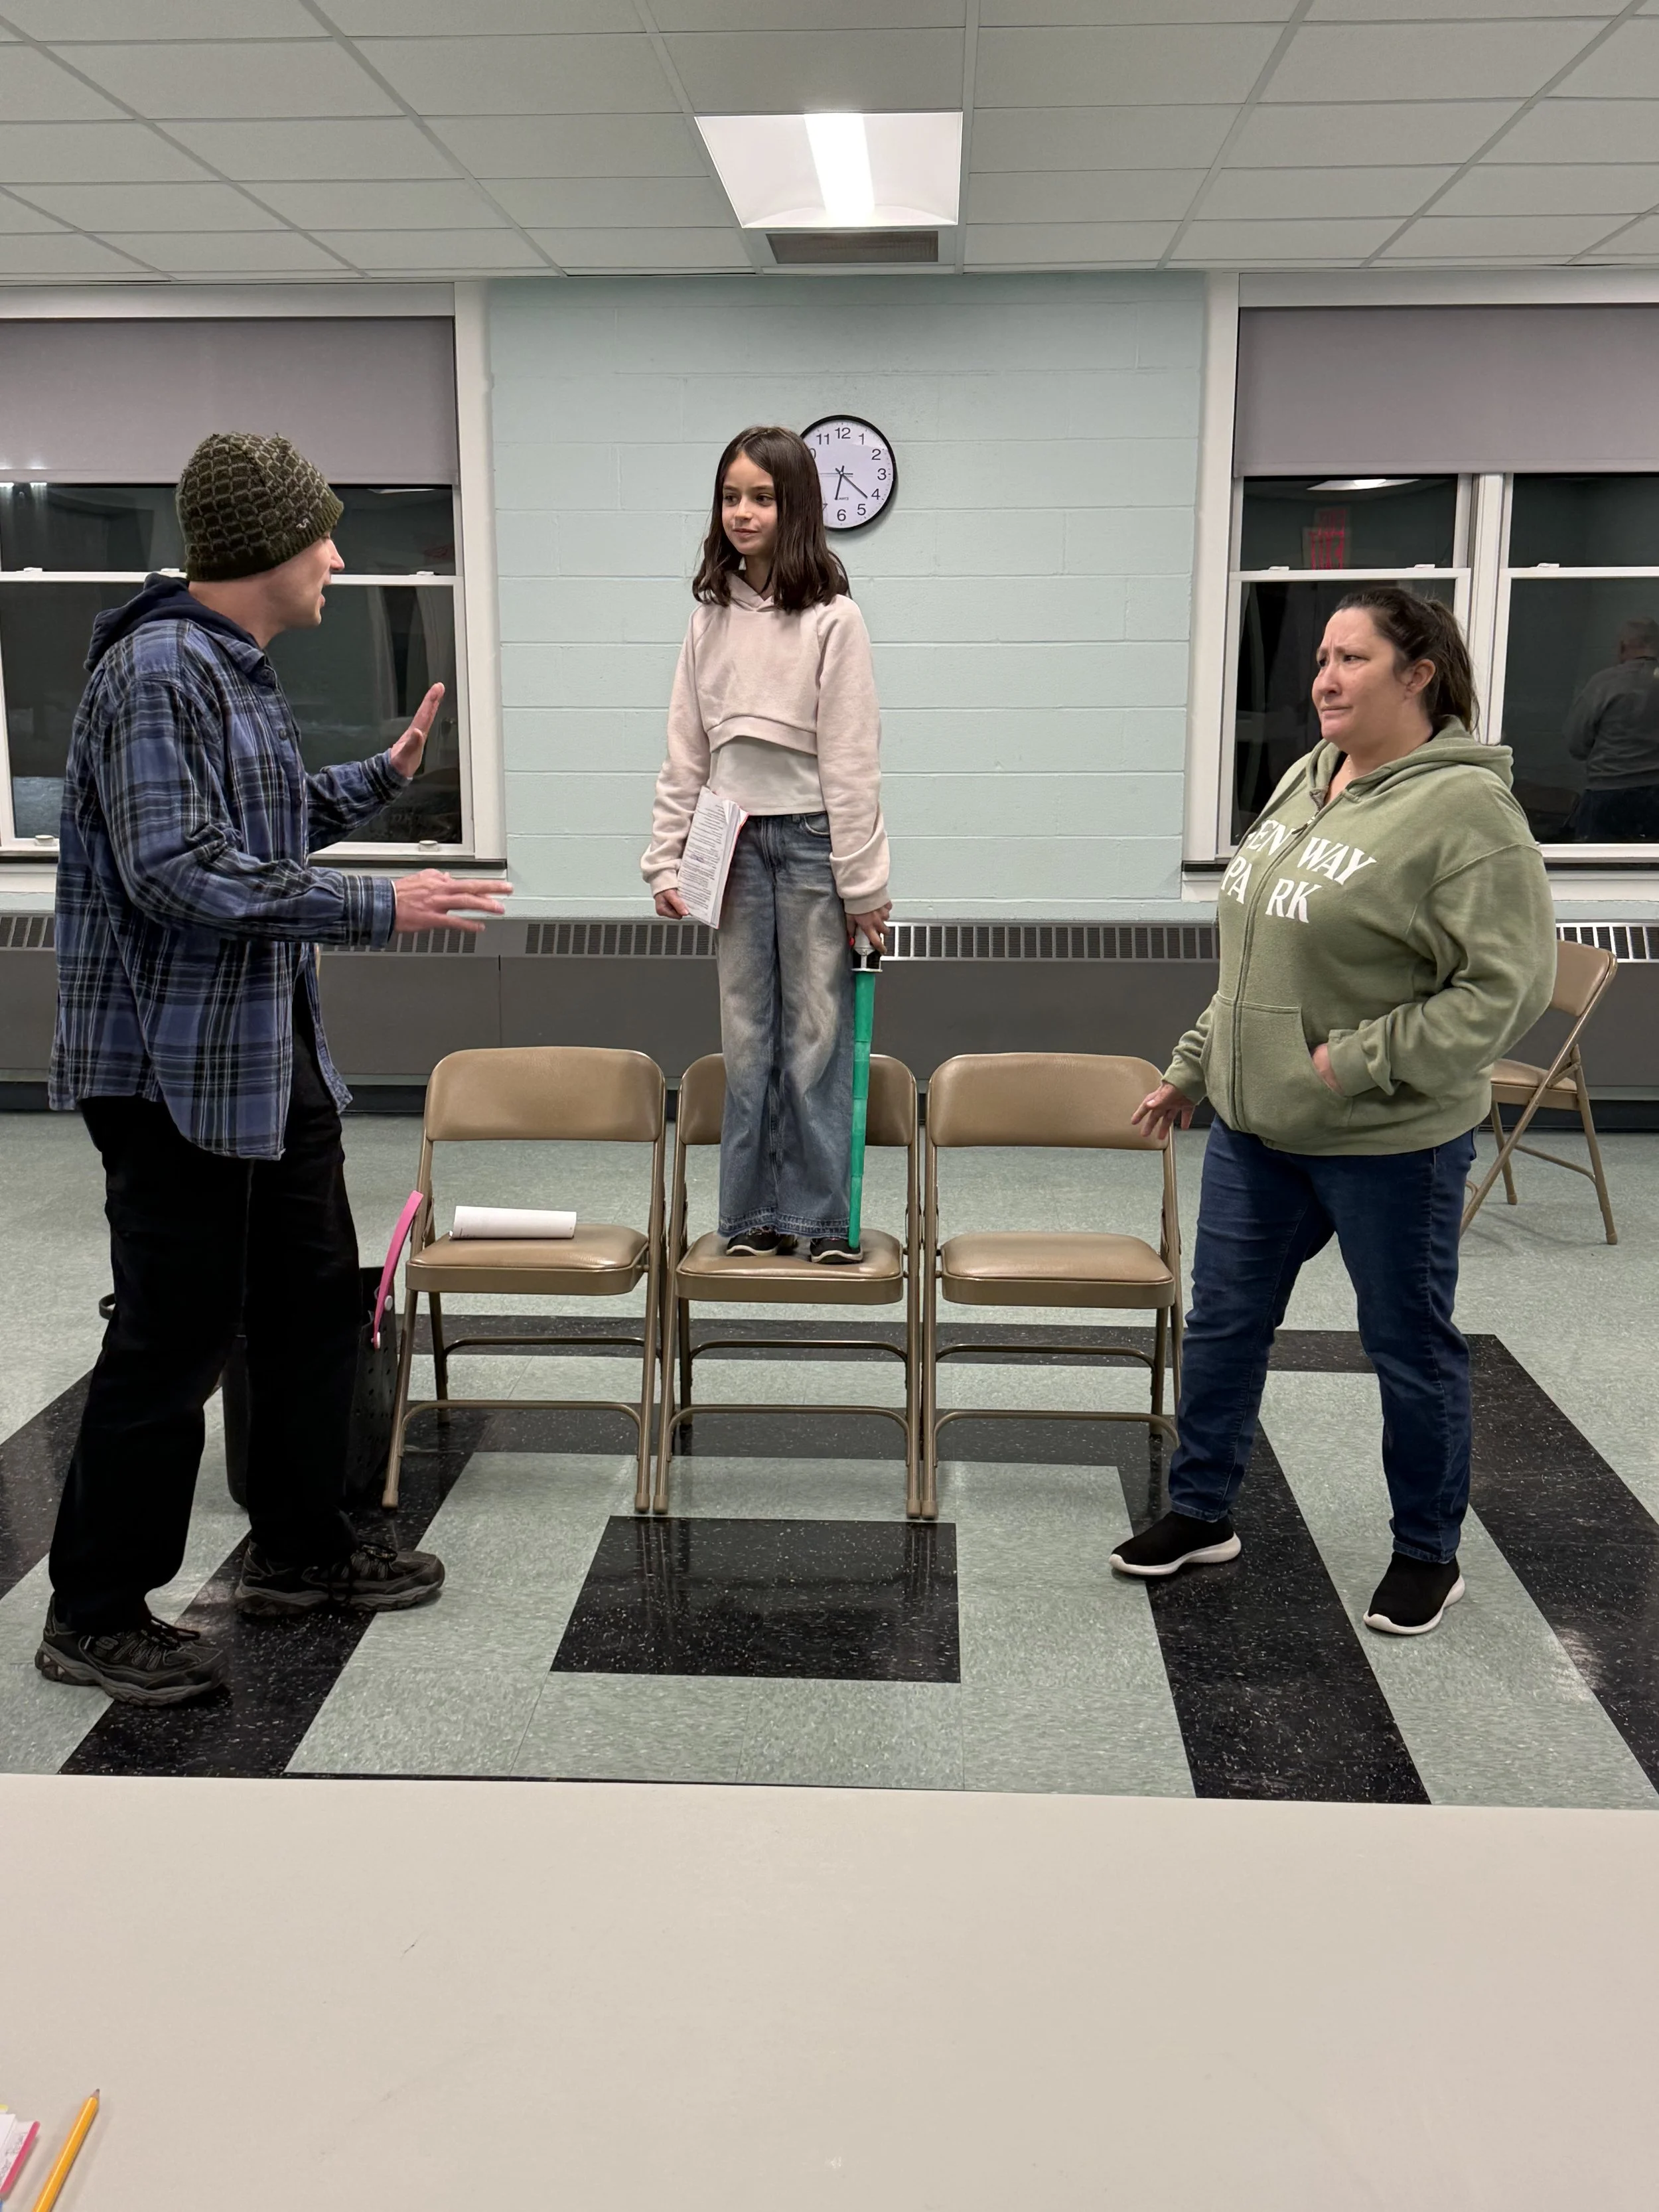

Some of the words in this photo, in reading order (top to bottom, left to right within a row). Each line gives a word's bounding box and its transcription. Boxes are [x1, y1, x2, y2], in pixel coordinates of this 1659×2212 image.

[816, 433, 830, 445] 11
[834, 427, 851, 439] 12
[859, 433, 865, 445] 1
[871, 449, 881, 460] 2
[877, 468, 887, 480] 3
[871, 488, 881, 500] 4
[837, 509, 847, 521] 6
[857, 503, 867, 516] 5
[1246, 820, 1296, 856] EN
[1297, 836, 1377, 885] WAY
[1221, 855, 1252, 905] PA
[1265, 878, 1323, 923] RK
